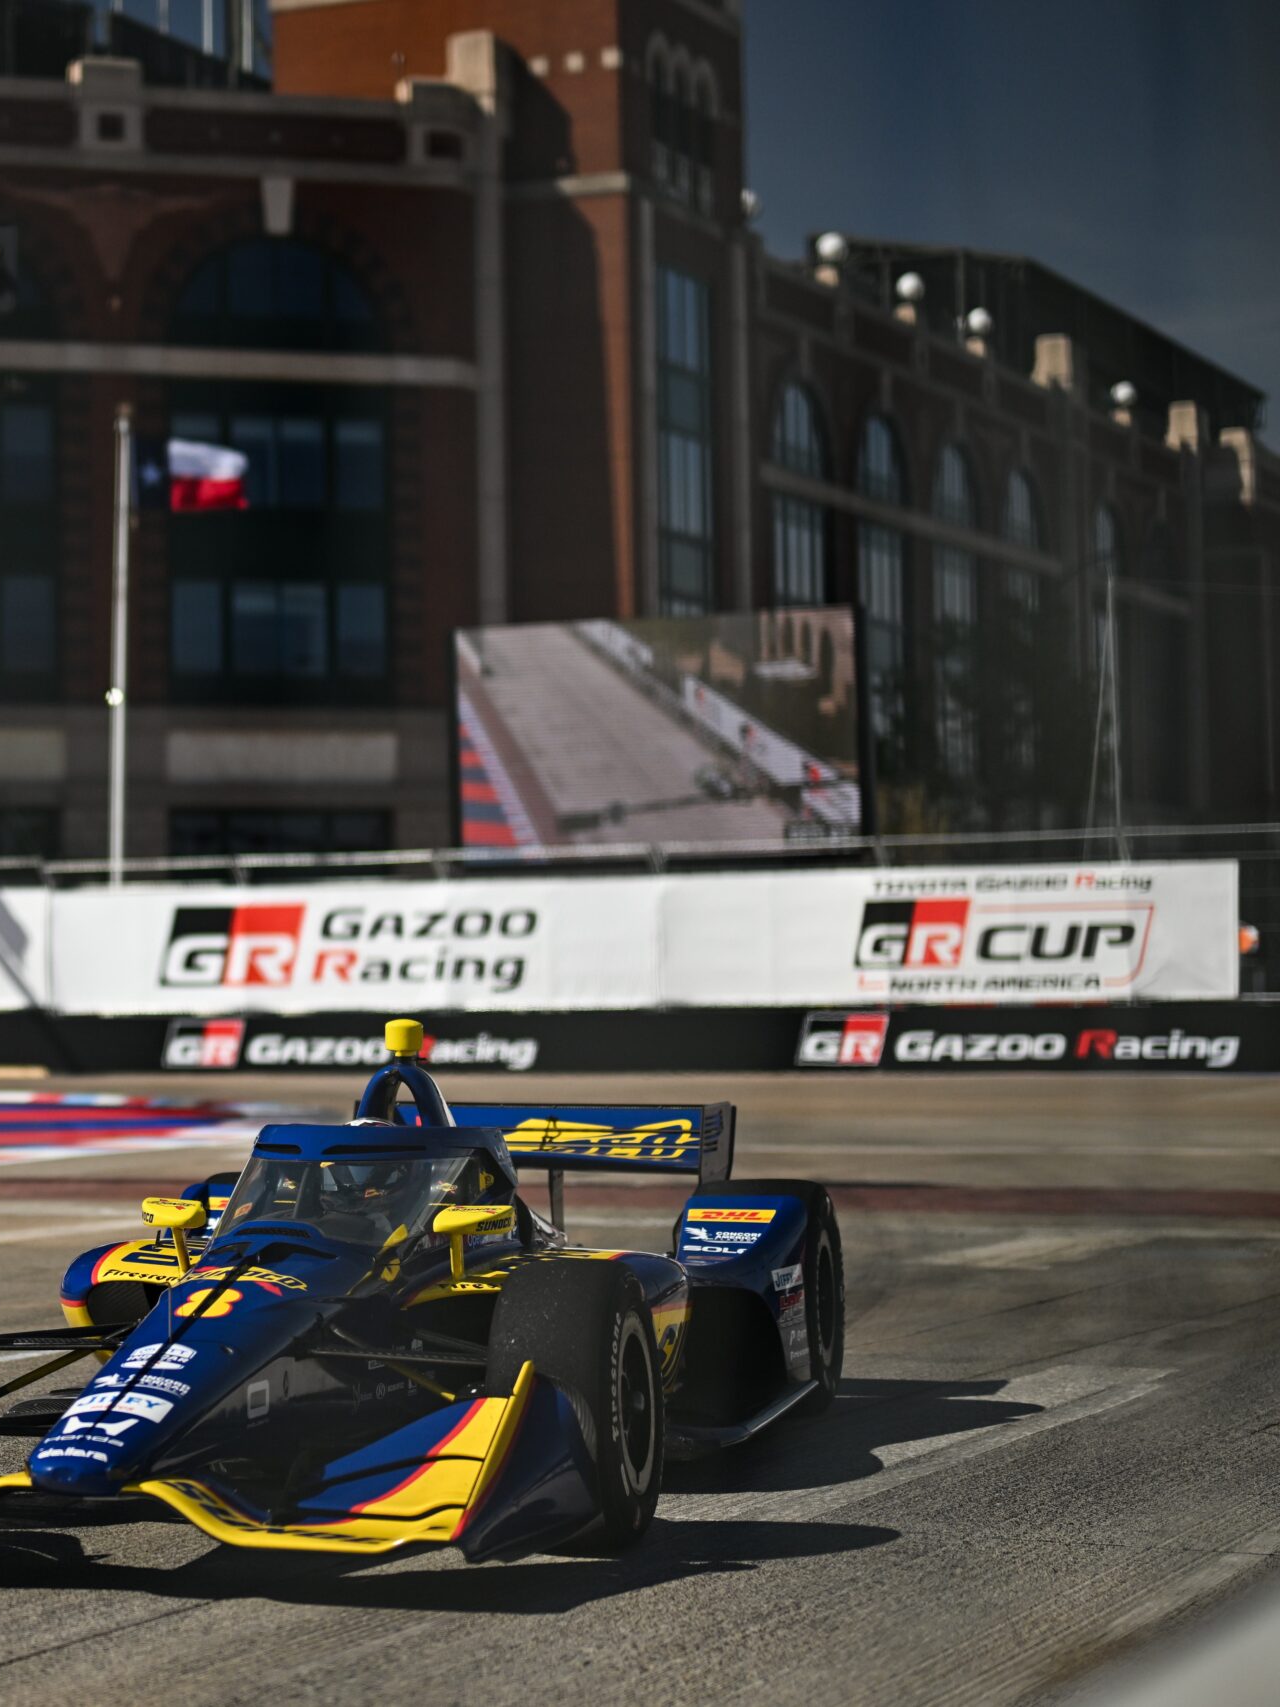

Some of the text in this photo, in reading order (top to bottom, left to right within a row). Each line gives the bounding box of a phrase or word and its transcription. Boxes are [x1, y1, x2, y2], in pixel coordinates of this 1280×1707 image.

[320, 905, 539, 941] GAZOO
[159, 933, 297, 988] GR
[855, 922, 1135, 968] GR CUP
[311, 945, 526, 993] Racing
[244, 1033, 393, 1066] GAZOO
[800, 1028, 1240, 1068] GR GAZOO Racing
[700, 1211, 763, 1221] DHL
[173, 1287, 244, 1319] 8
